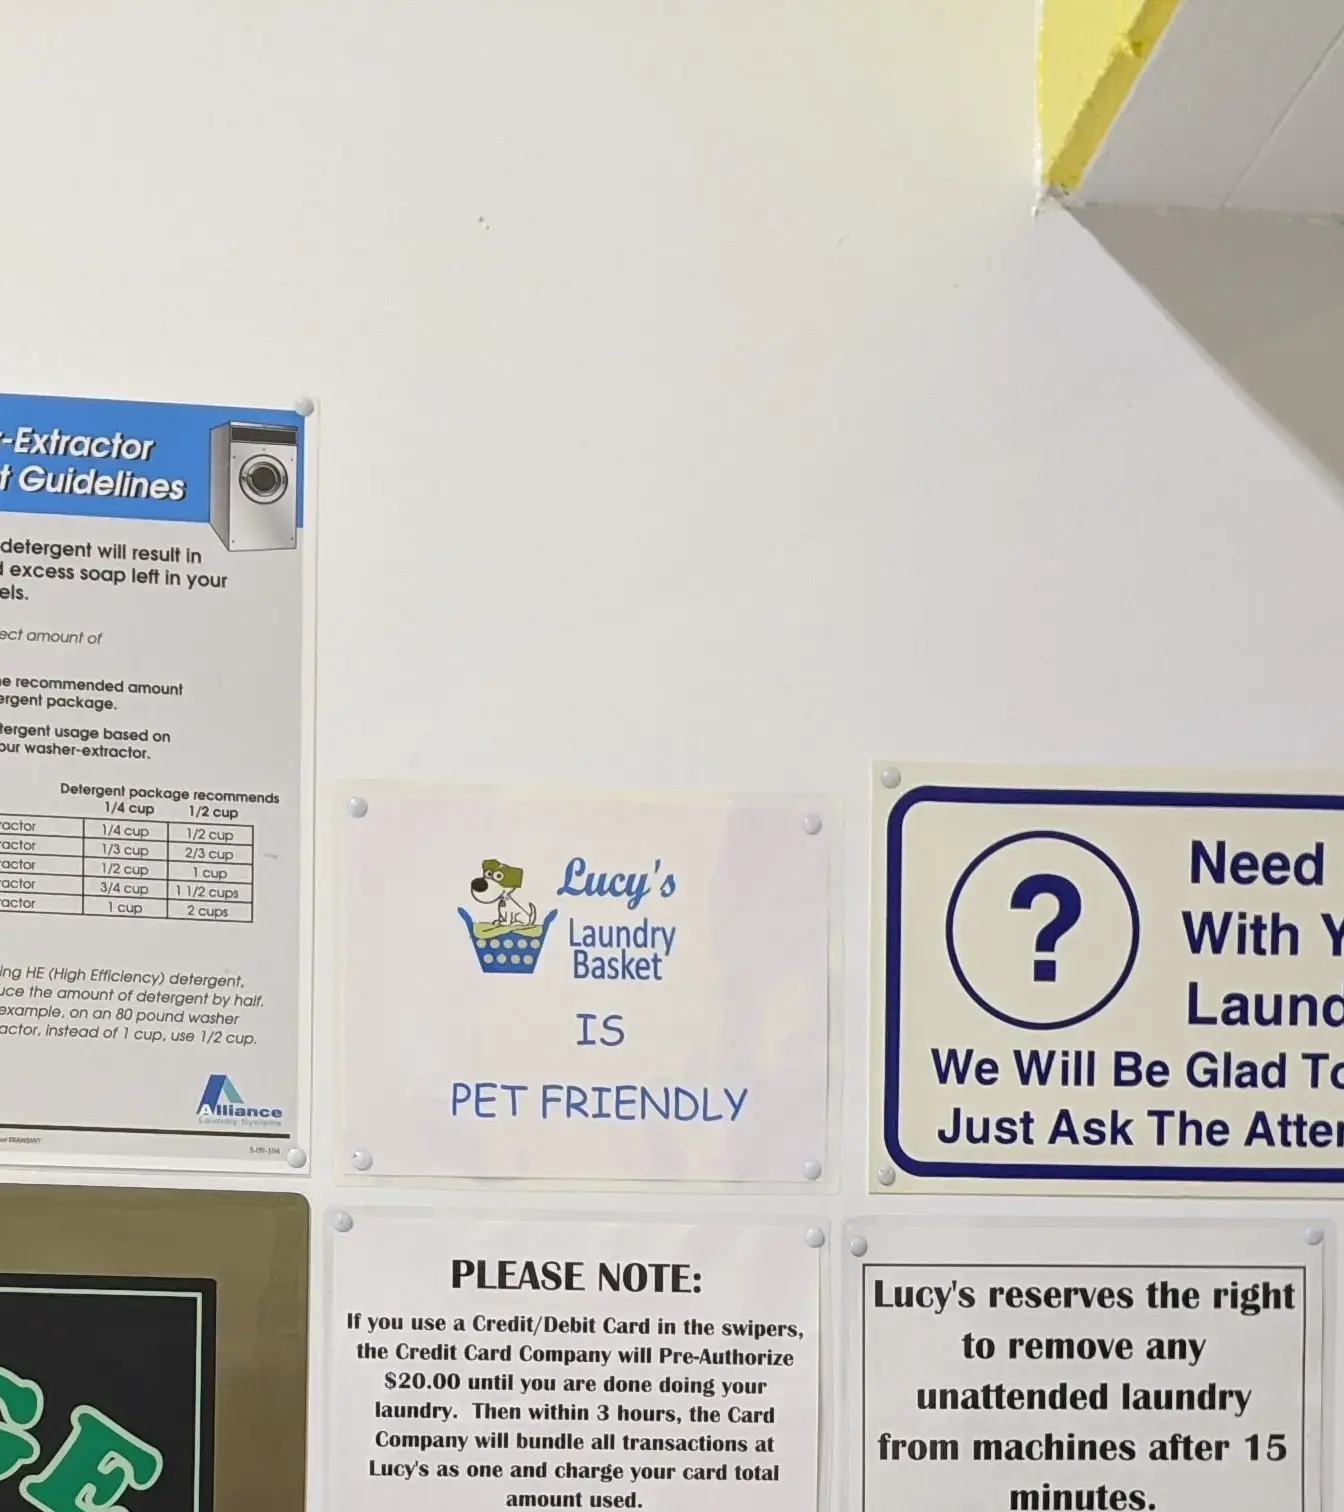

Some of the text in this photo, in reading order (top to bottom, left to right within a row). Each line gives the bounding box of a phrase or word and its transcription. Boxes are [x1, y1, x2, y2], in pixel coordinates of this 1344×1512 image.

[19, 465, 184, 500] Guidelines
[1191, 840, 1324, 886] Need
[557, 857, 676, 910] Lucy's
[570, 917, 676, 956] Laundry
[1182, 911, 1298, 956] With
[574, 948, 662, 980] Basket
[576, 1013, 624, 1046] IS
[931, 1048, 999, 1085] We
[1013, 1050, 1095, 1086] Will
[1114, 1051, 1169, 1088] Be
[1186, 1051, 1286, 1089] Glad
[197, 1103, 283, 1118] Alliance
[452, 1083, 748, 1121] PET FRIENDLY
[938, 1107, 1034, 1145] Just
[1048, 1109, 1134, 1145] Ask
[1147, 1110, 1229, 1147] The
[452, 1260, 701, 1293] PLEASE NOTE:
[875, 1280, 1295, 1316] Lucy's reserves the right
[348, 1313, 803, 1340] If you use a Credit/Debit Card in the swipers,
[917, 1382, 1252, 1417] unattended laundry
[877, 1433, 1286, 1461] from machines after 15
[1011, 1483, 1155, 1511] minutes.
